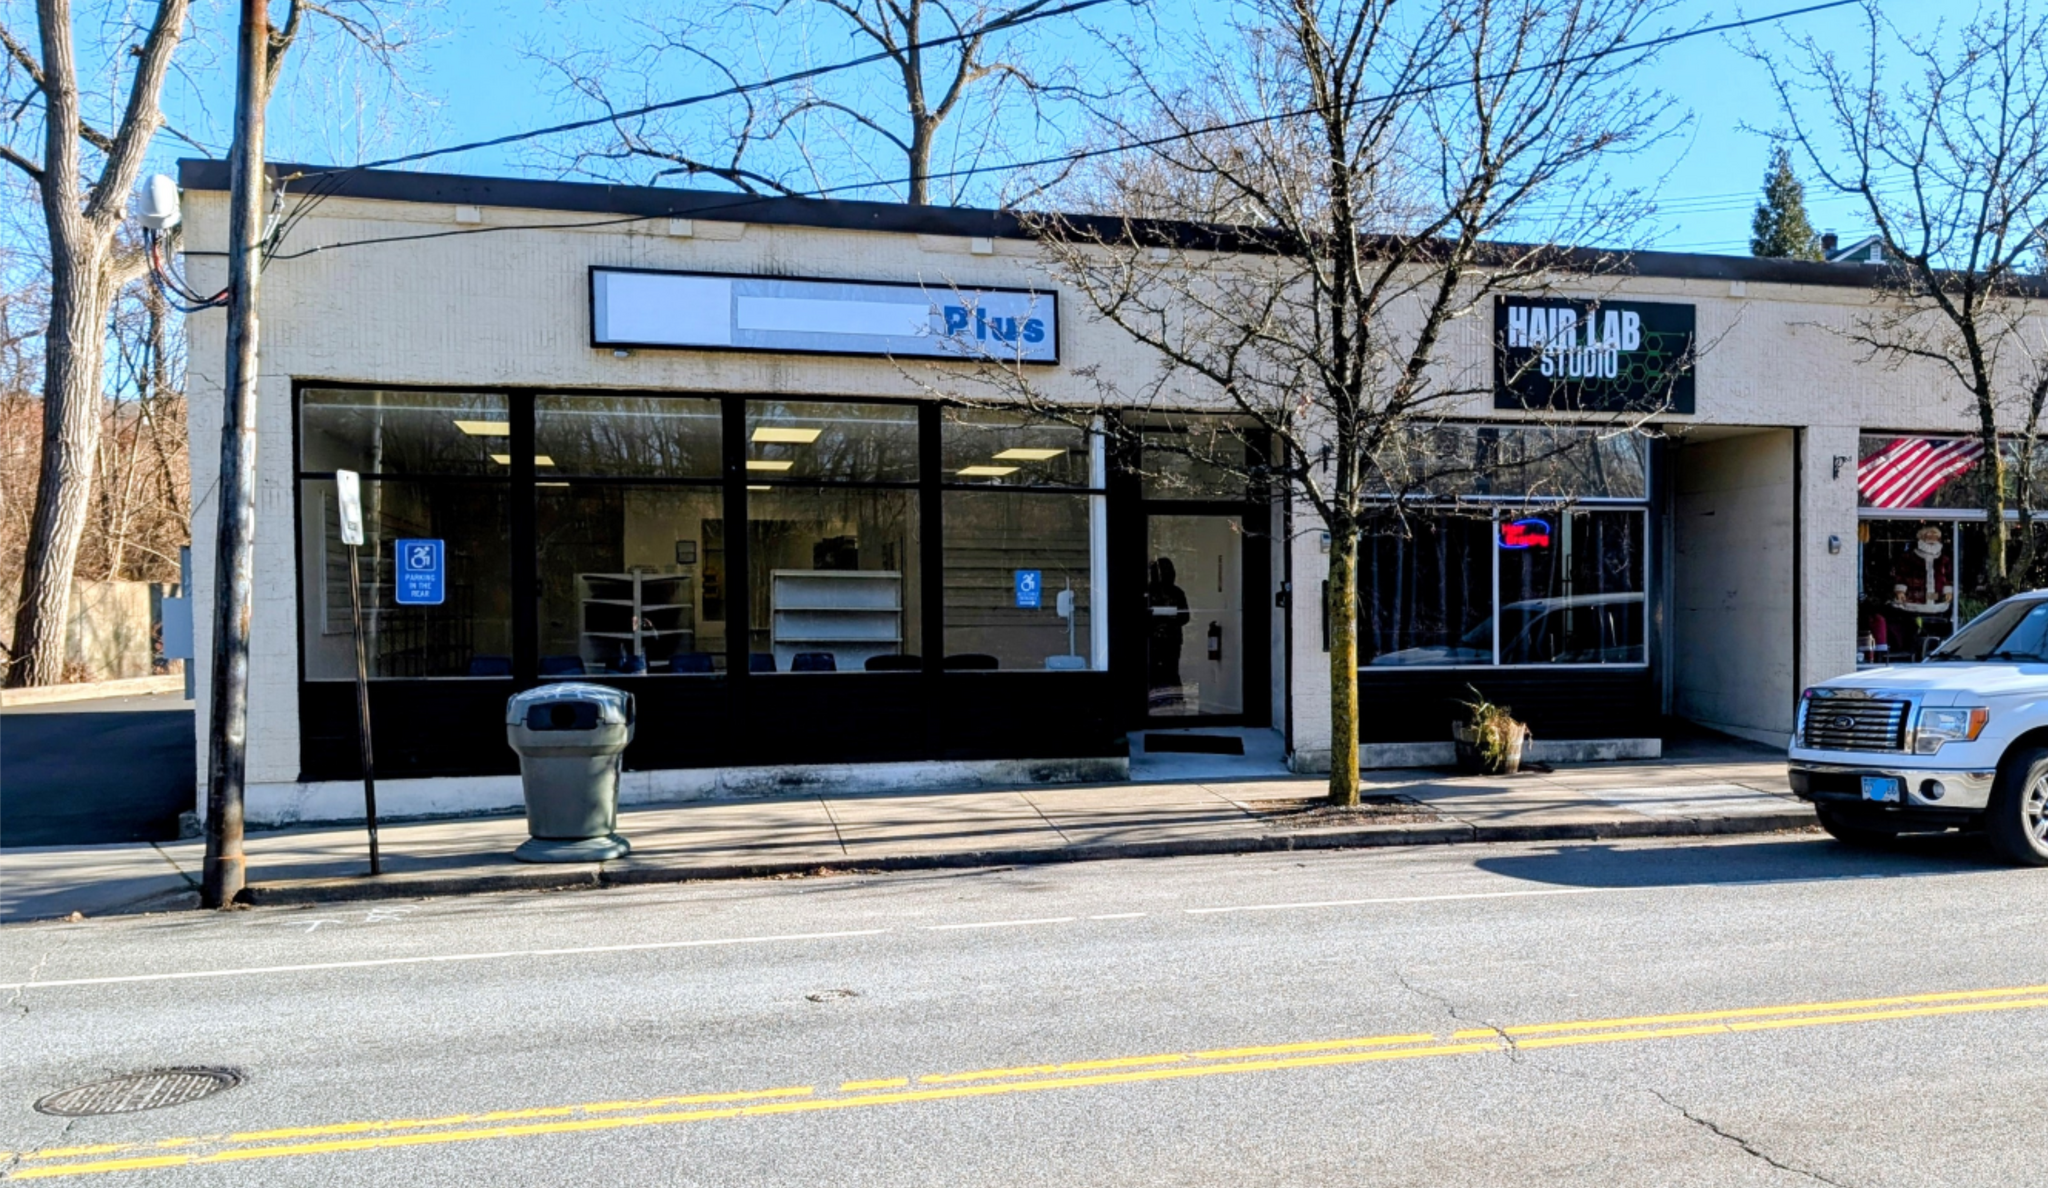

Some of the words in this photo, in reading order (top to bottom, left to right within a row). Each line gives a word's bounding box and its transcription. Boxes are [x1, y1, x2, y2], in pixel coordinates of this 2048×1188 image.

[944, 305, 1045, 343] Plus
[1508, 306, 1577, 350] HAIR
[1587, 310, 1640, 351] LAB
[1540, 347, 1618, 378] STUDIO
